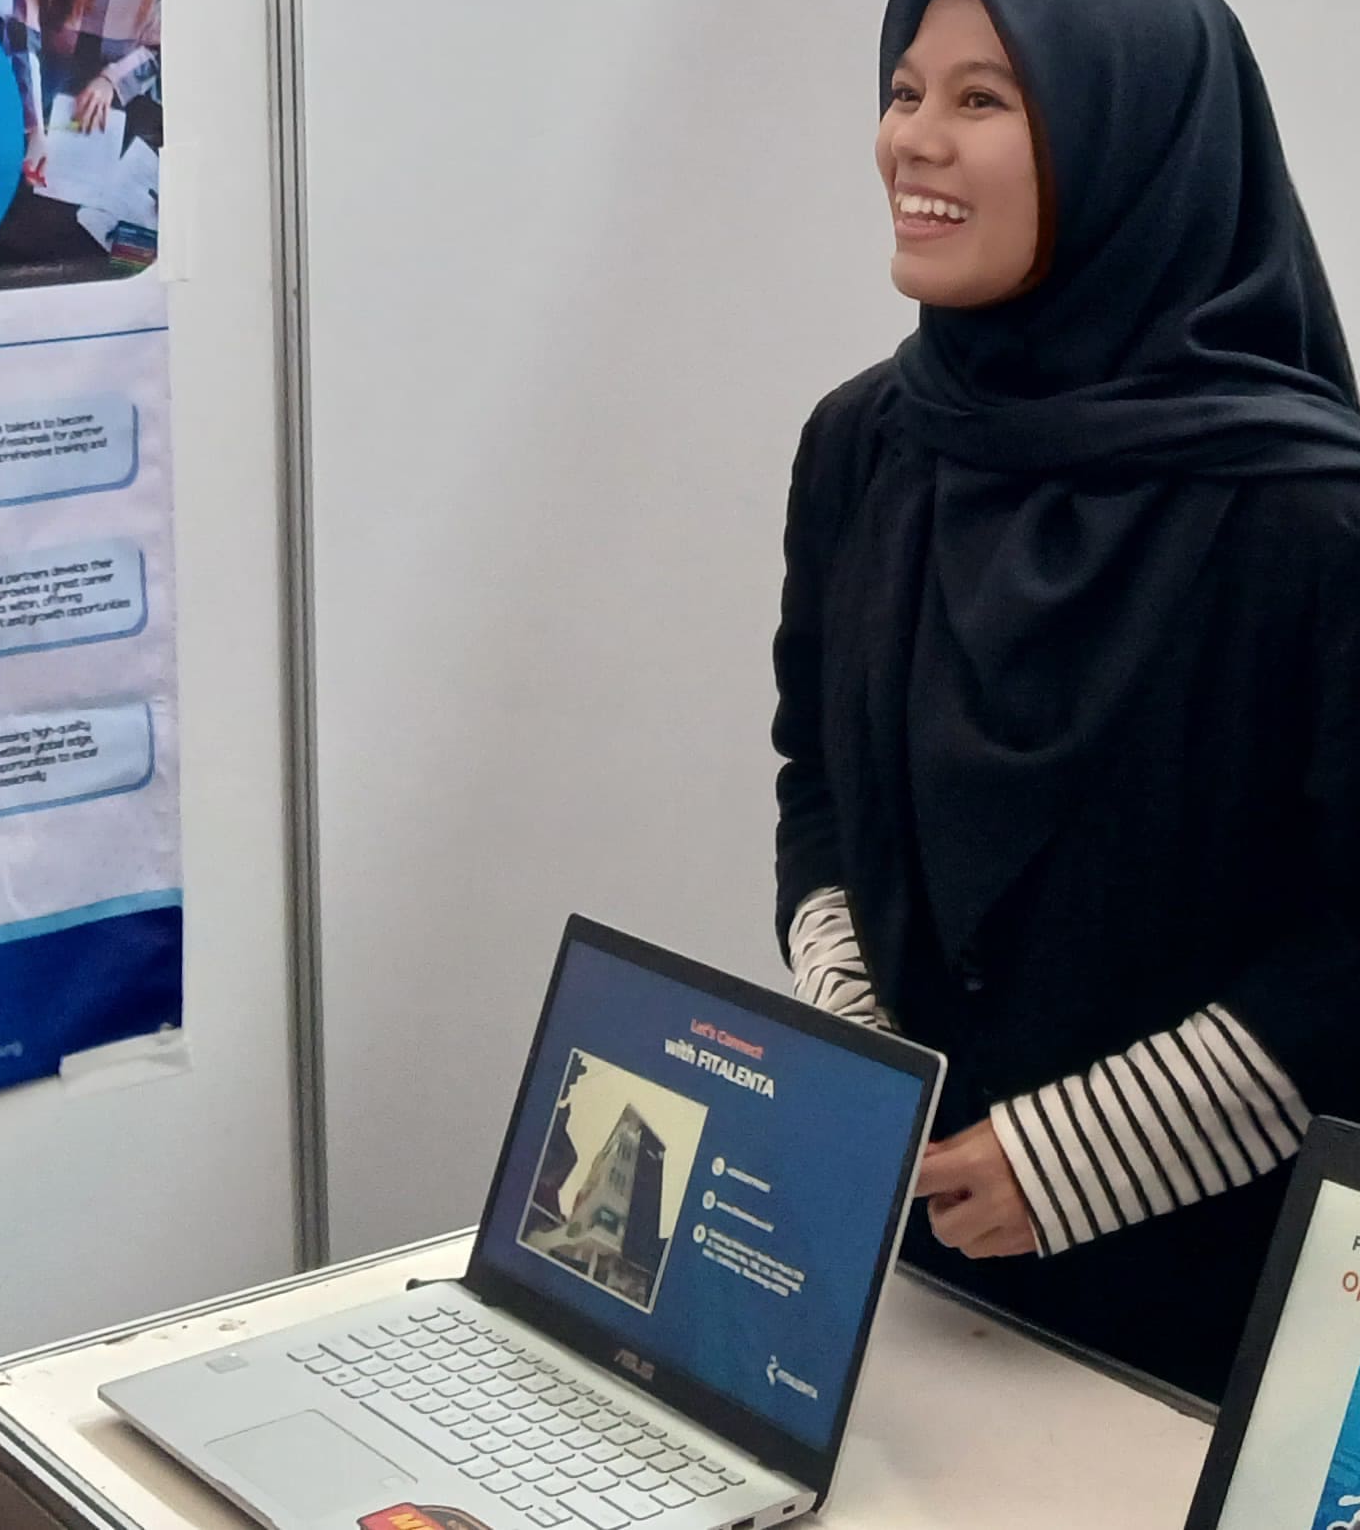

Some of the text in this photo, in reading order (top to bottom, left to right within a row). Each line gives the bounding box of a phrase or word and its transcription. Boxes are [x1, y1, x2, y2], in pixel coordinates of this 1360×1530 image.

[53, 429, 69, 442] for
[664, 1038, 774, 1100] with FITALENTA
